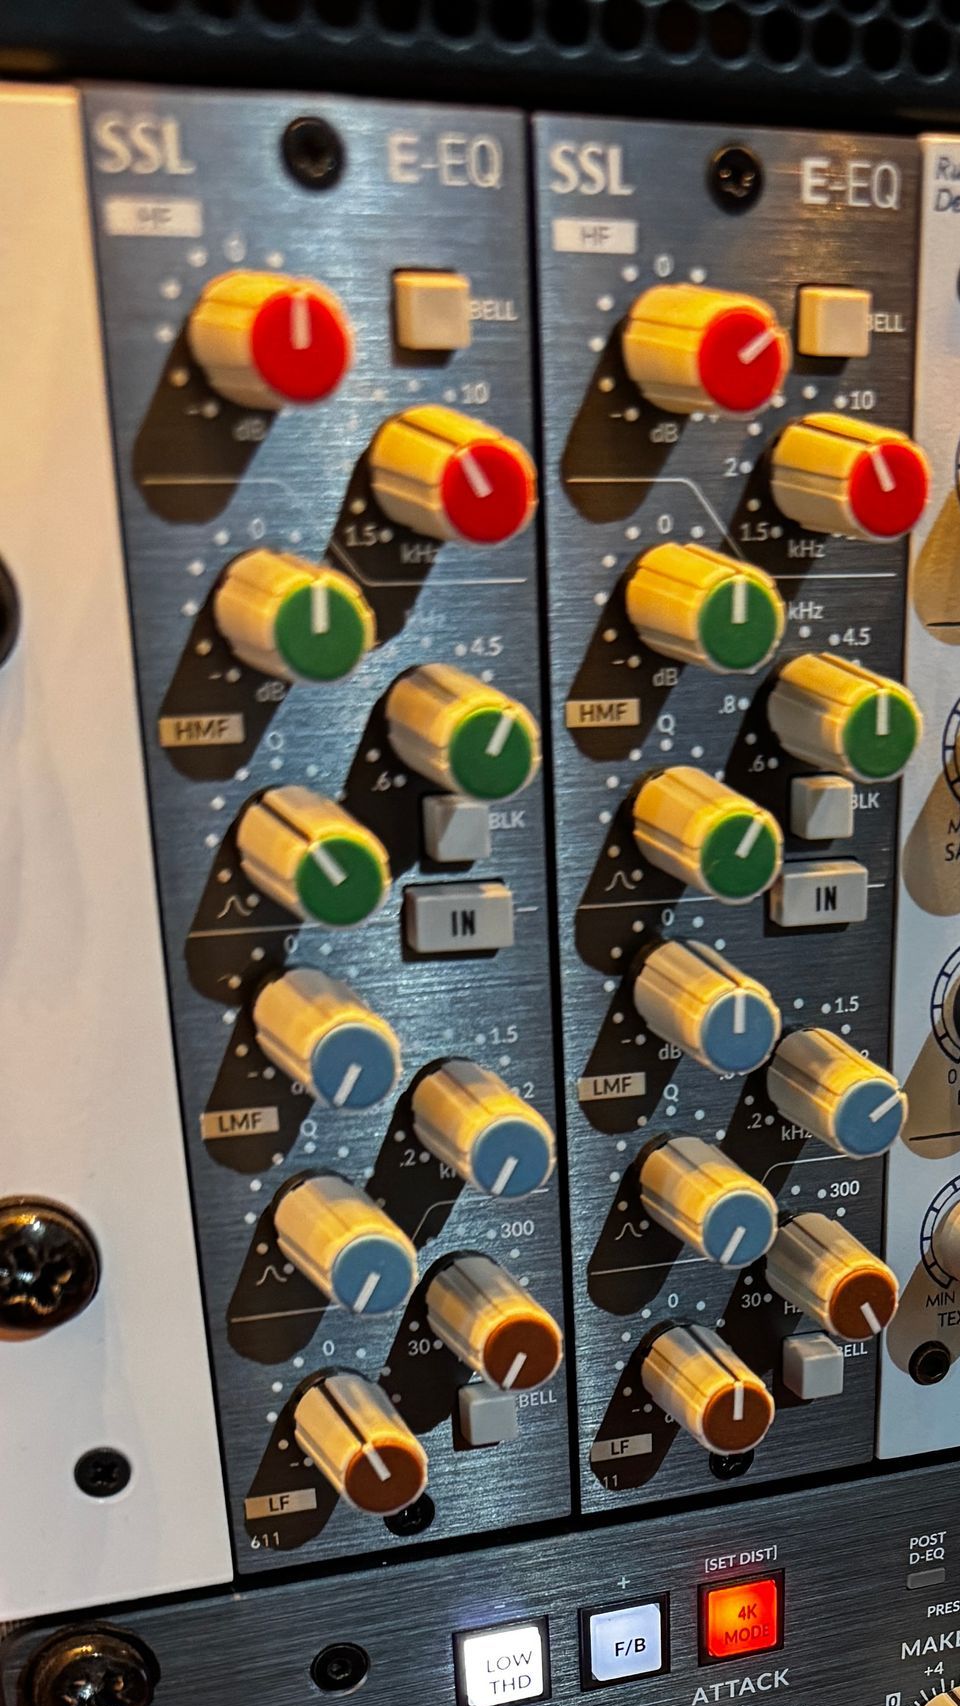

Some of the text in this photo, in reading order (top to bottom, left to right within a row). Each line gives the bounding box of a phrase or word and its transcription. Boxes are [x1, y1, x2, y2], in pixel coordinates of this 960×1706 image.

[96, 110, 195, 175] SSL
[389, 135, 501, 189] E-EQ
[549, 142, 635, 196] SSL
[802, 158, 899, 209] E-EQ
[850, 391, 874, 410] 10
[789, 603, 823, 620] kHz
[471, 637, 502, 655] 4.5
[843, 629, 870, 645] 4.5
[580, 704, 627, 721] HMF
[175, 720, 229, 740] HMF
[488, 812, 524, 828] BLK
[815, 887, 836, 911] IN
[451, 912, 475, 935] IN
[835, 997, 859, 1013] 1.5
[489, 1027, 518, 1045] 1.5
[593, 1077, 632, 1095] LMF
[218, 1113, 262, 1133] LMF
[830, 1181, 859, 1197] 300
[502, 1221, 534, 1238] 300
[742, 1293, 761, 1307] 30
[926, 1291, 956, 1308] MIN
[408, 1339, 430, 1355] 30
[519, 1391, 557, 1408] BELL
[611, 1440, 629, 1455] LF
[269, 1496, 289, 1512] LF
[251, 1532, 279, 1549] 611
[909, 1532, 947, 1549] POST
[704, 1545, 778, 1573] [SET DIST]
[909, 1547, 944, 1565] D-EQ
[738, 1603, 757, 1621] 4K
[724, 1624, 770, 1647] MODE
[614, 1637, 647, 1657] F/B
[486, 1650, 533, 1674] LOW
[488, 1674, 532, 1696] THD
[692, 1668, 790, 1706] ATTACK
